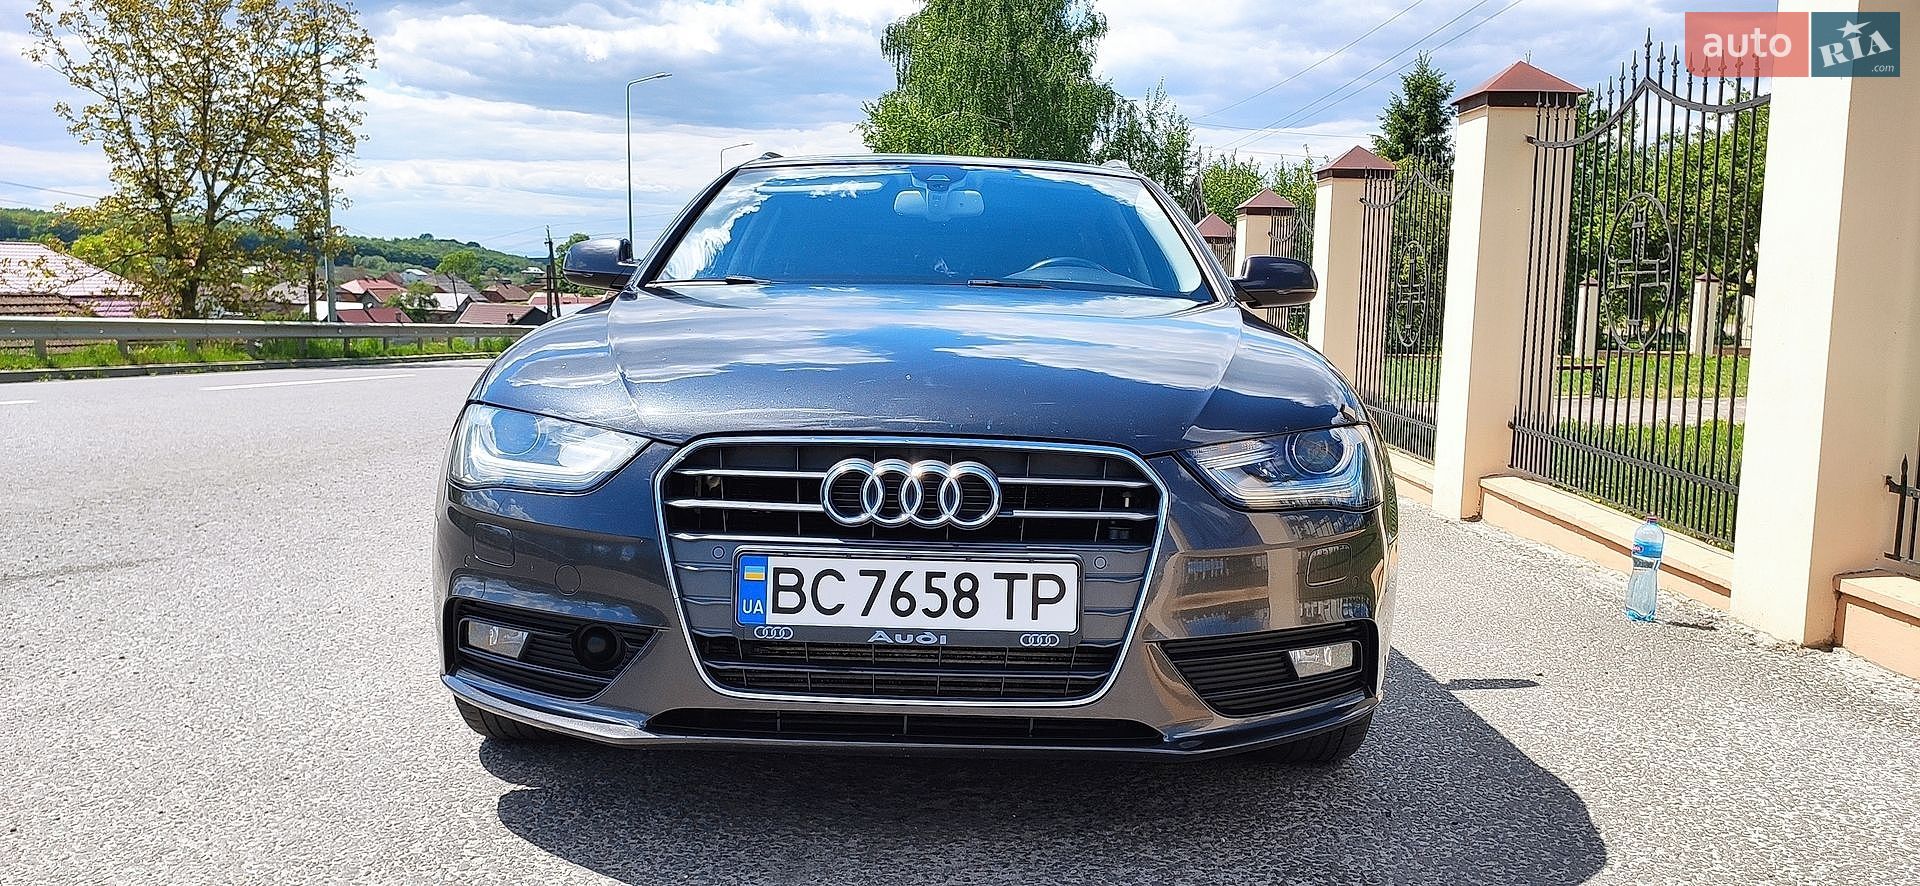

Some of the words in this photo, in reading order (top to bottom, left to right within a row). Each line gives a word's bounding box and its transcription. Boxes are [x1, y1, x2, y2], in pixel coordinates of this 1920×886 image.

[771, 567, 846, 616] BC
[859, 569, 980, 620] 7658
[993, 572, 1067, 621] TP
[742, 599, 764, 615] UA
[867, 630, 947, 645] Audi
